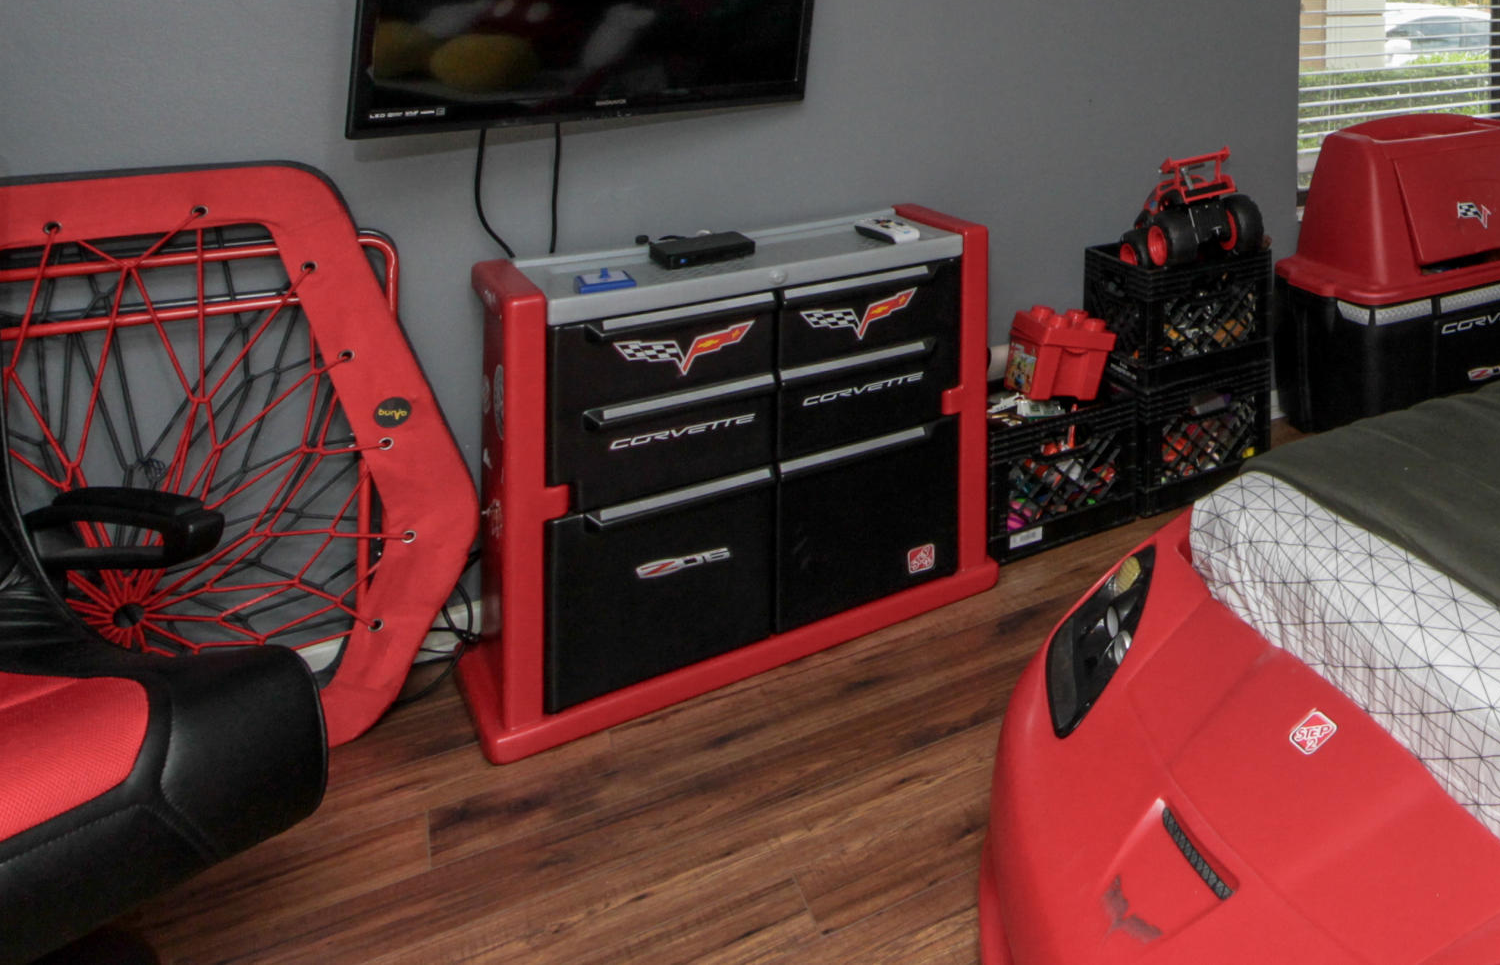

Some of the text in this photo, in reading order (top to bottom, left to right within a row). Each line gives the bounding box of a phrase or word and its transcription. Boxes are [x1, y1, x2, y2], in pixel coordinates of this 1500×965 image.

[802, 371, 924, 407] CORVETTE
[609, 413, 756, 450] CORVETTE
[1294, 724, 1331, 741] STEP
[1305, 737, 1318, 752] 2
